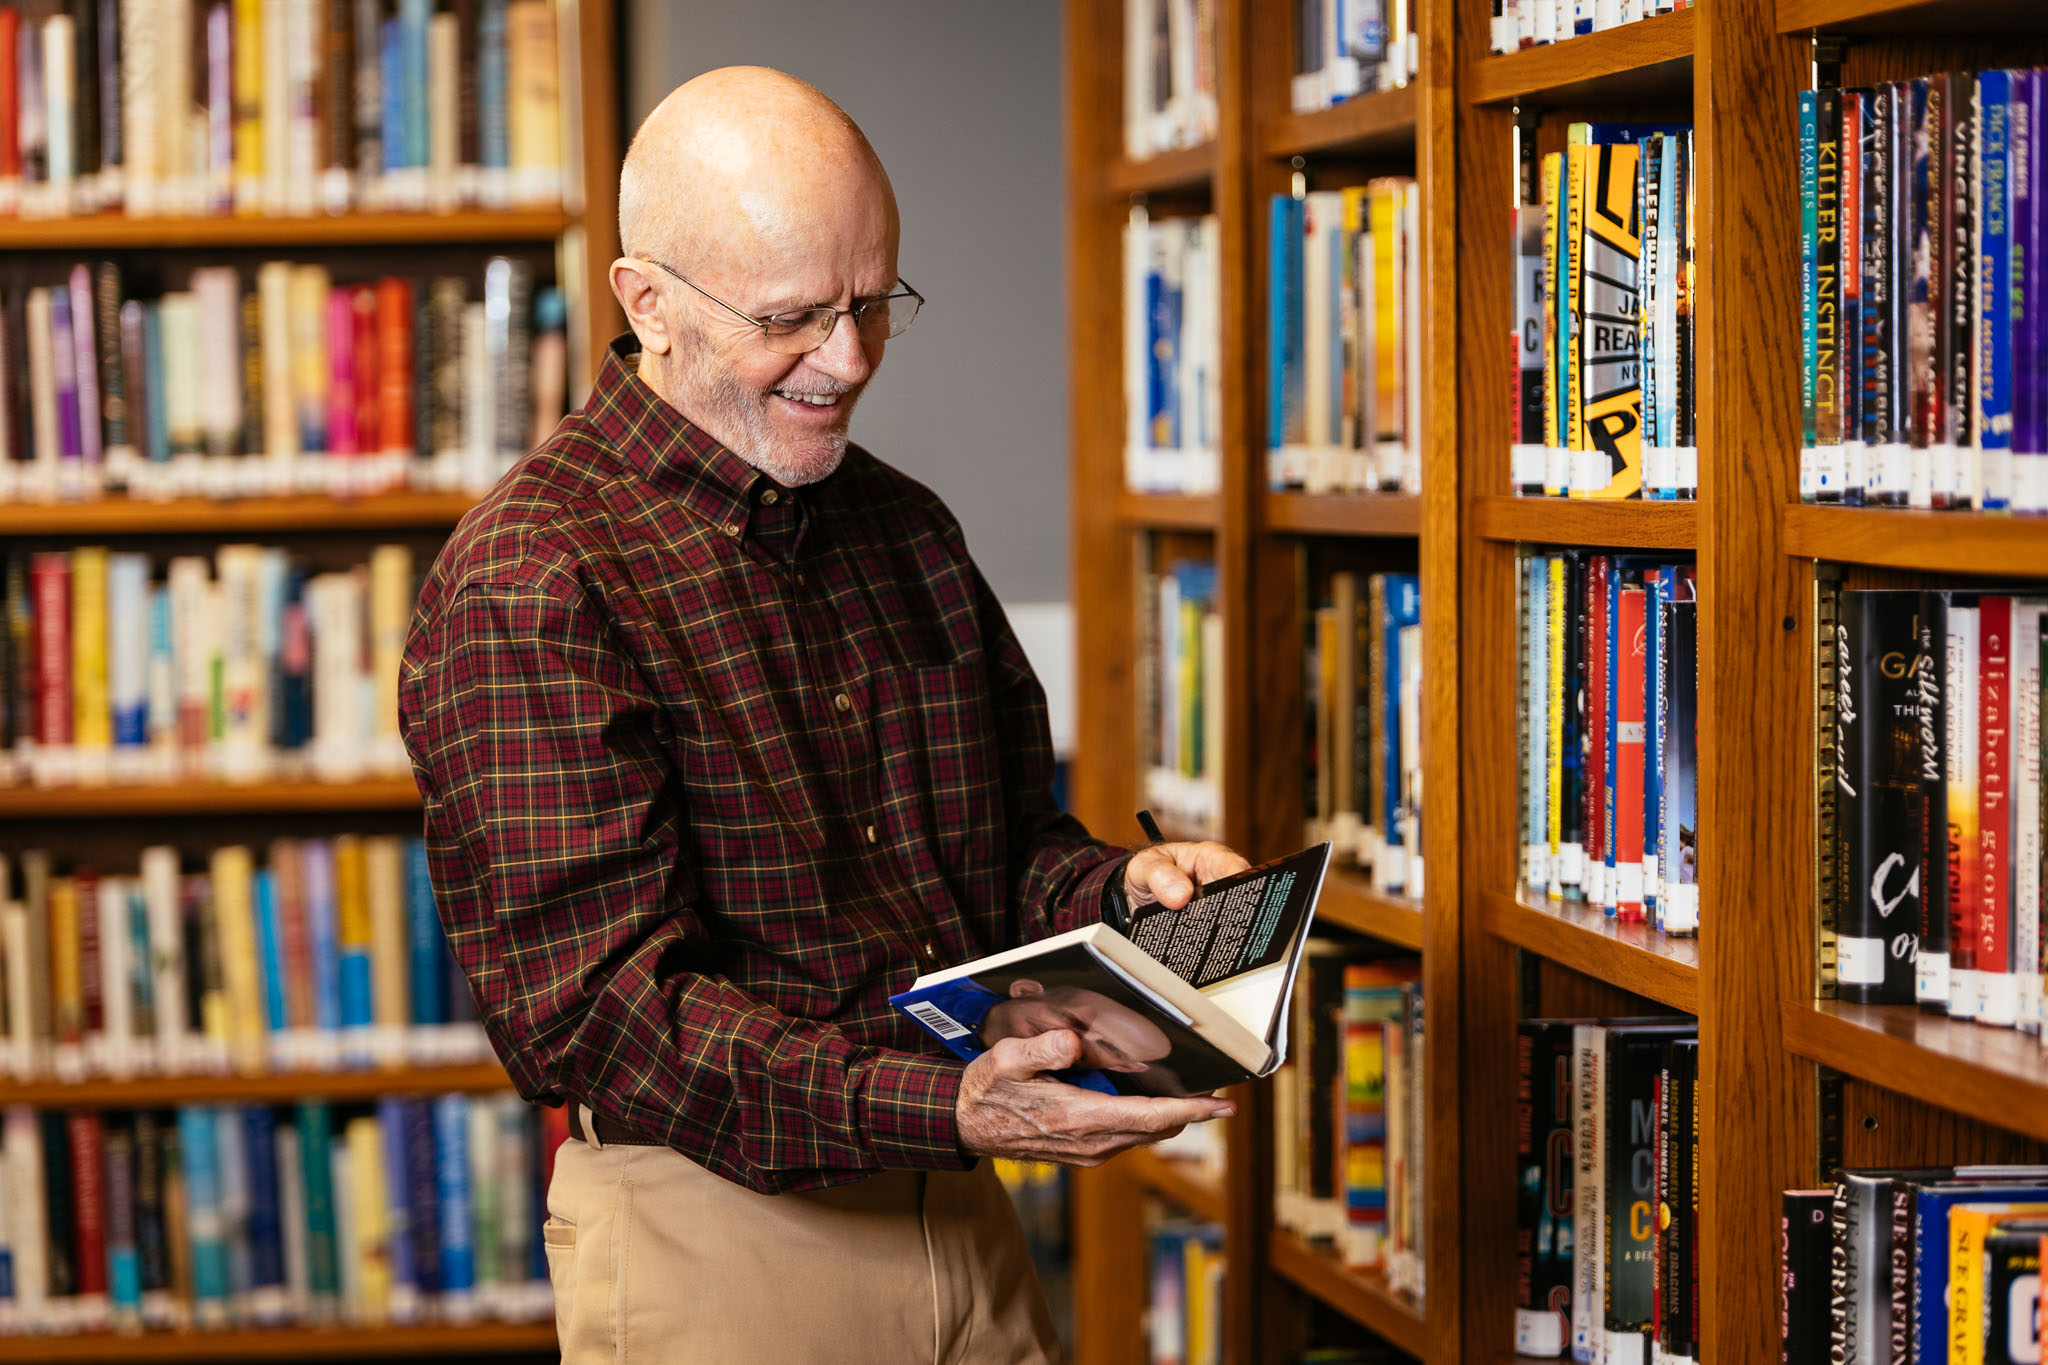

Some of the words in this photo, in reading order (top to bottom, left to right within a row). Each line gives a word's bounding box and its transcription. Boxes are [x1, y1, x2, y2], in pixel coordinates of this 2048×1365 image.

[1989, 104, 2005, 154] DICK
[1804, 123, 1815, 209] CHARLES
[1817, 139, 1837, 249] KILLER
[1957, 121, 1967, 214] VINCE
[1646, 182, 1659, 221] LEE
[1989, 159, 2005, 237] FRANCIS
[1646, 225, 1659, 287] CHILD
[1803, 232, 1811, 257] THE
[1803, 262, 1811, 313] WOMAN
[1957, 227, 1967, 325] FLYNN
[1594, 325, 1641, 352] REA
[1803, 317, 1811, 329] IN
[1803, 336, 1811, 360] THE
[1817, 264, 1837, 414] INSTINCT
[1568, 348, 1577, 444] PERSONAL
[1803, 365, 1811, 409] WATER
[1836, 624, 1857, 725] career
[1983, 634, 2007, 809] elizabeth
[1979, 829, 1997, 953] george
[1581, 1047, 1593, 1113] HARLAN
[1660, 1068, 1670, 1125] MICHAEL
[1669, 1078, 1680, 1137] MICHAEL
[1691, 1079, 1699, 1138] MICHAEL
[1660, 1130, 1670, 1199] CONNELLY
[1669, 1140, 1680, 1209] CONNELLY
[1691, 1143, 1699, 1212] CONNELLY
[1669, 1215, 1680, 1249] NINE
[1811, 1208, 1826, 1224] D
[1832, 1183, 1848, 1241] SUE
[1892, 1191, 1909, 1241] SUE
[1669, 1249, 1680, 1316] DRAGONS
[1956, 1231, 1970, 1279] SUE
